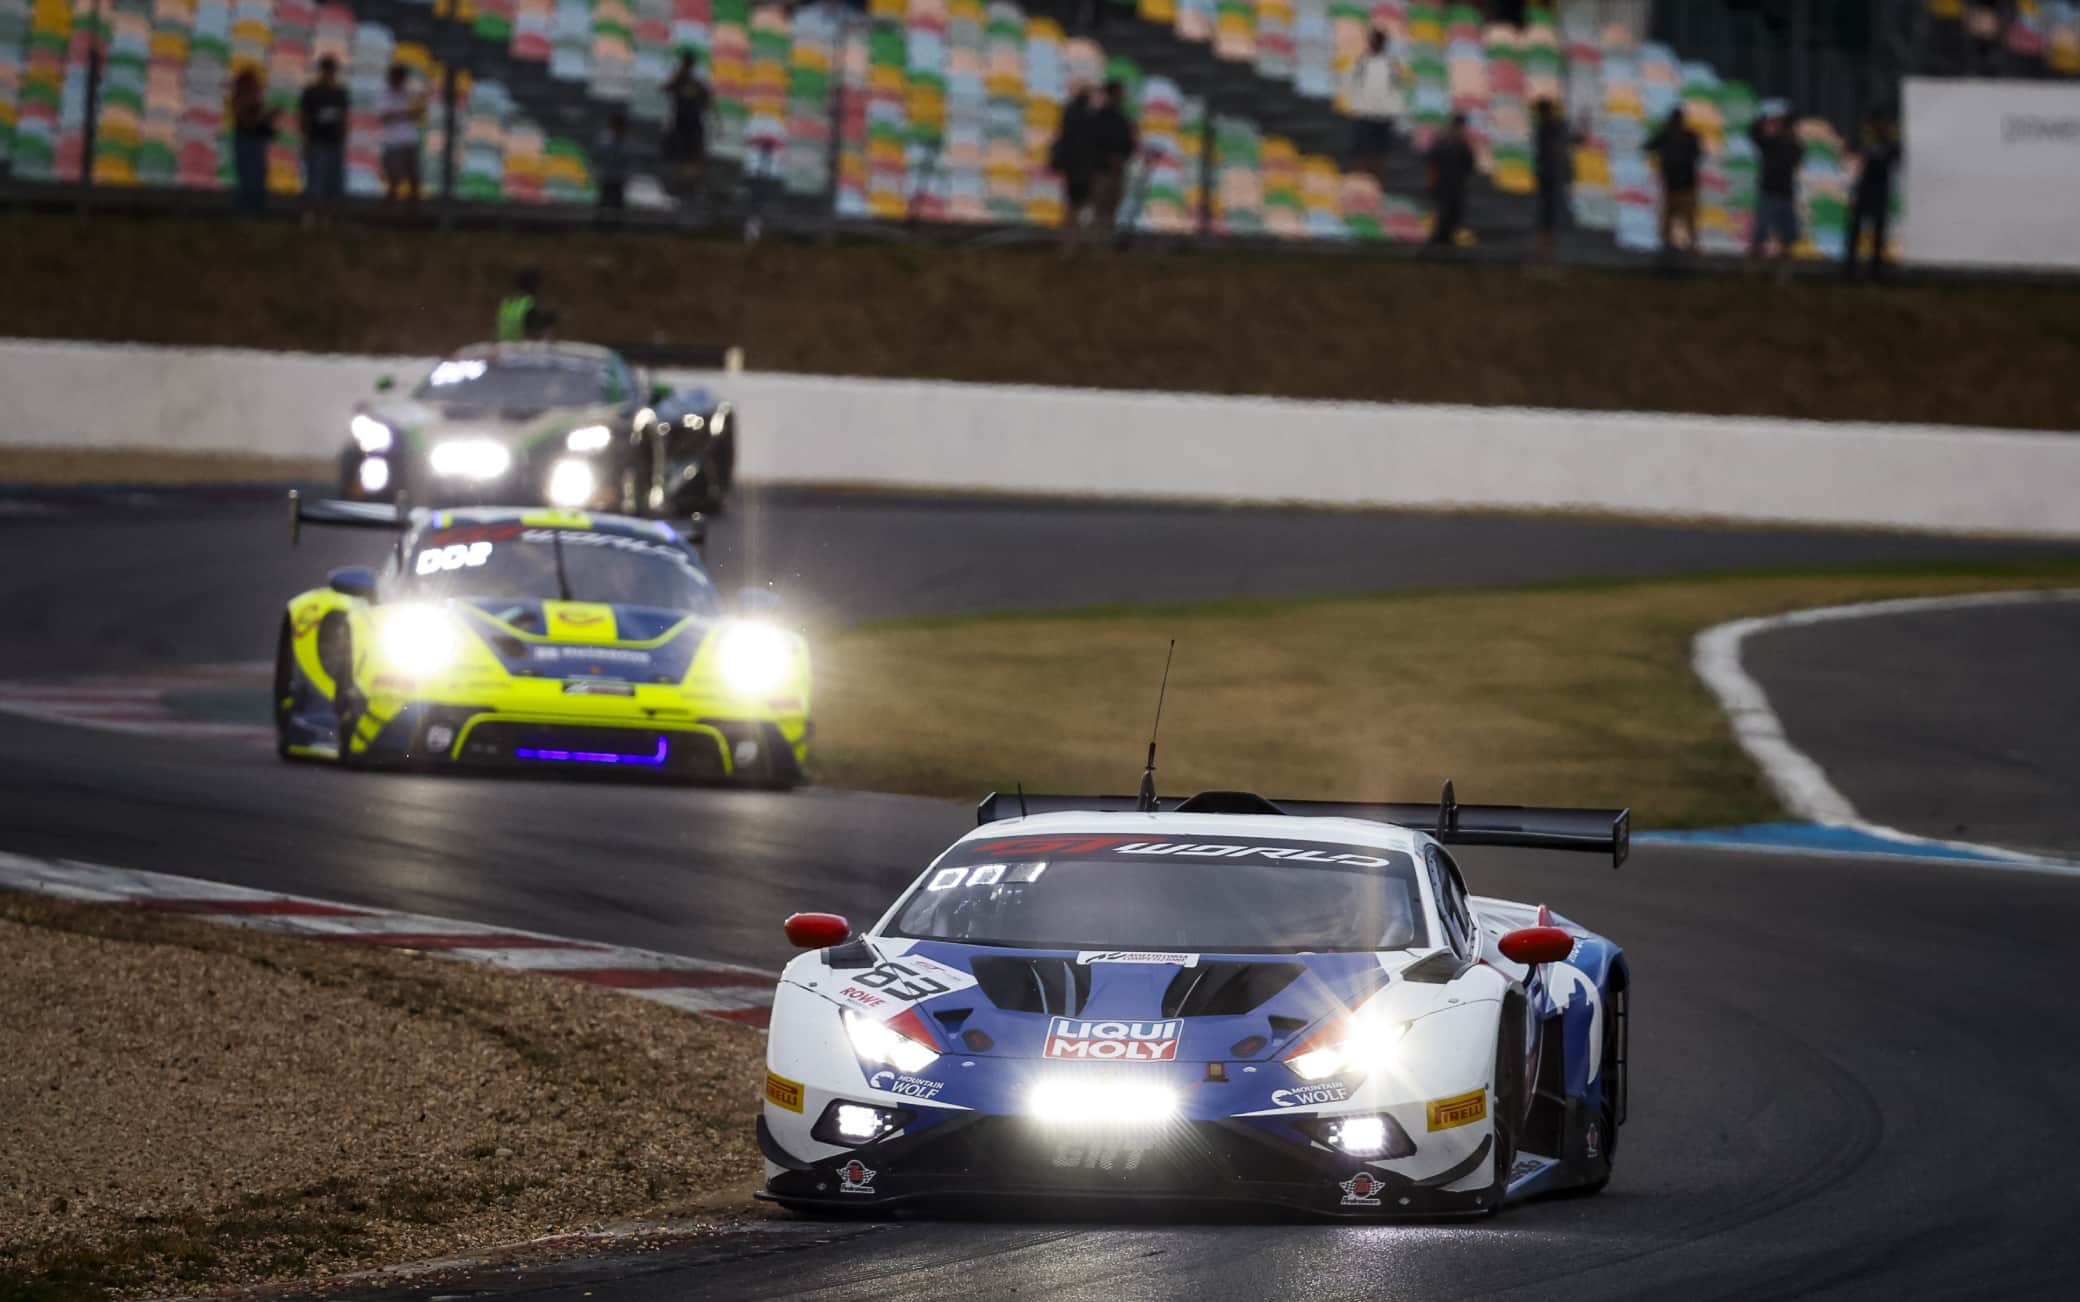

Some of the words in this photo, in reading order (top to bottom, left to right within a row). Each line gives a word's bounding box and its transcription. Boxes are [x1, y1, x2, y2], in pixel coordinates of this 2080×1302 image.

[1112, 842, 1390, 868] WORLD
[840, 987, 886, 1008] ROWE
[1056, 1020, 1176, 1040] LIQUI
[1052, 1038, 1176, 1059] MOLY
[891, 1080, 939, 1098] WOLF
[898, 1076, 944, 1089] MOUNTAIN
[1291, 1080, 1344, 1094] MOUNTAIN
[1294, 1088, 1347, 1105] WOLF
[1434, 1095, 1483, 1126] PIRELLI
